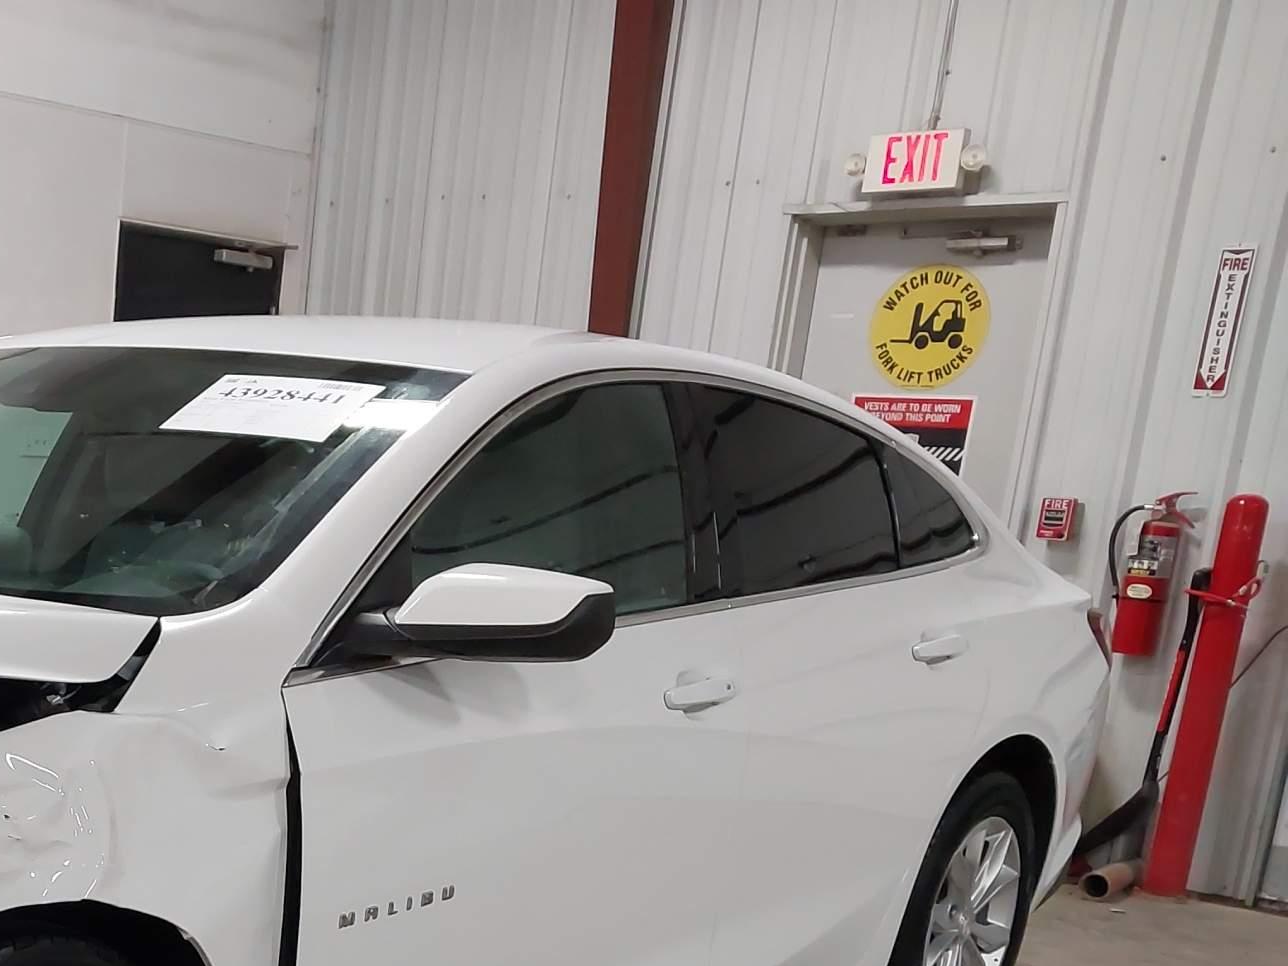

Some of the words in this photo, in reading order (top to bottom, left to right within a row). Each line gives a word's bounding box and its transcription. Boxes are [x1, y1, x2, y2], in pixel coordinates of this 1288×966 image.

[881, 132, 949, 185] EXIT
[1222, 258, 1249, 271] FIRE
[883, 272, 929, 311] WATCH
[934, 270, 963, 288] OUT
[960, 282, 982, 312] FOR
[1206, 273, 1237, 383] EXTINGUISHER
[876, 342, 898, 375] FORK
[896, 367, 923, 384] LIFT
[927, 345, 973, 383] TRUCKS
[219, 387, 346, 404] 43928441
[864, 401, 890, 411] VESTS
[909, 403, 920, 412] TO
[934, 403, 962, 414] WORN
[905, 412, 924, 422] THIS
[925, 413, 952, 423] POINT
[1044, 499, 1069, 509] FIRE
[338, 885, 455, 929] MALIBU
